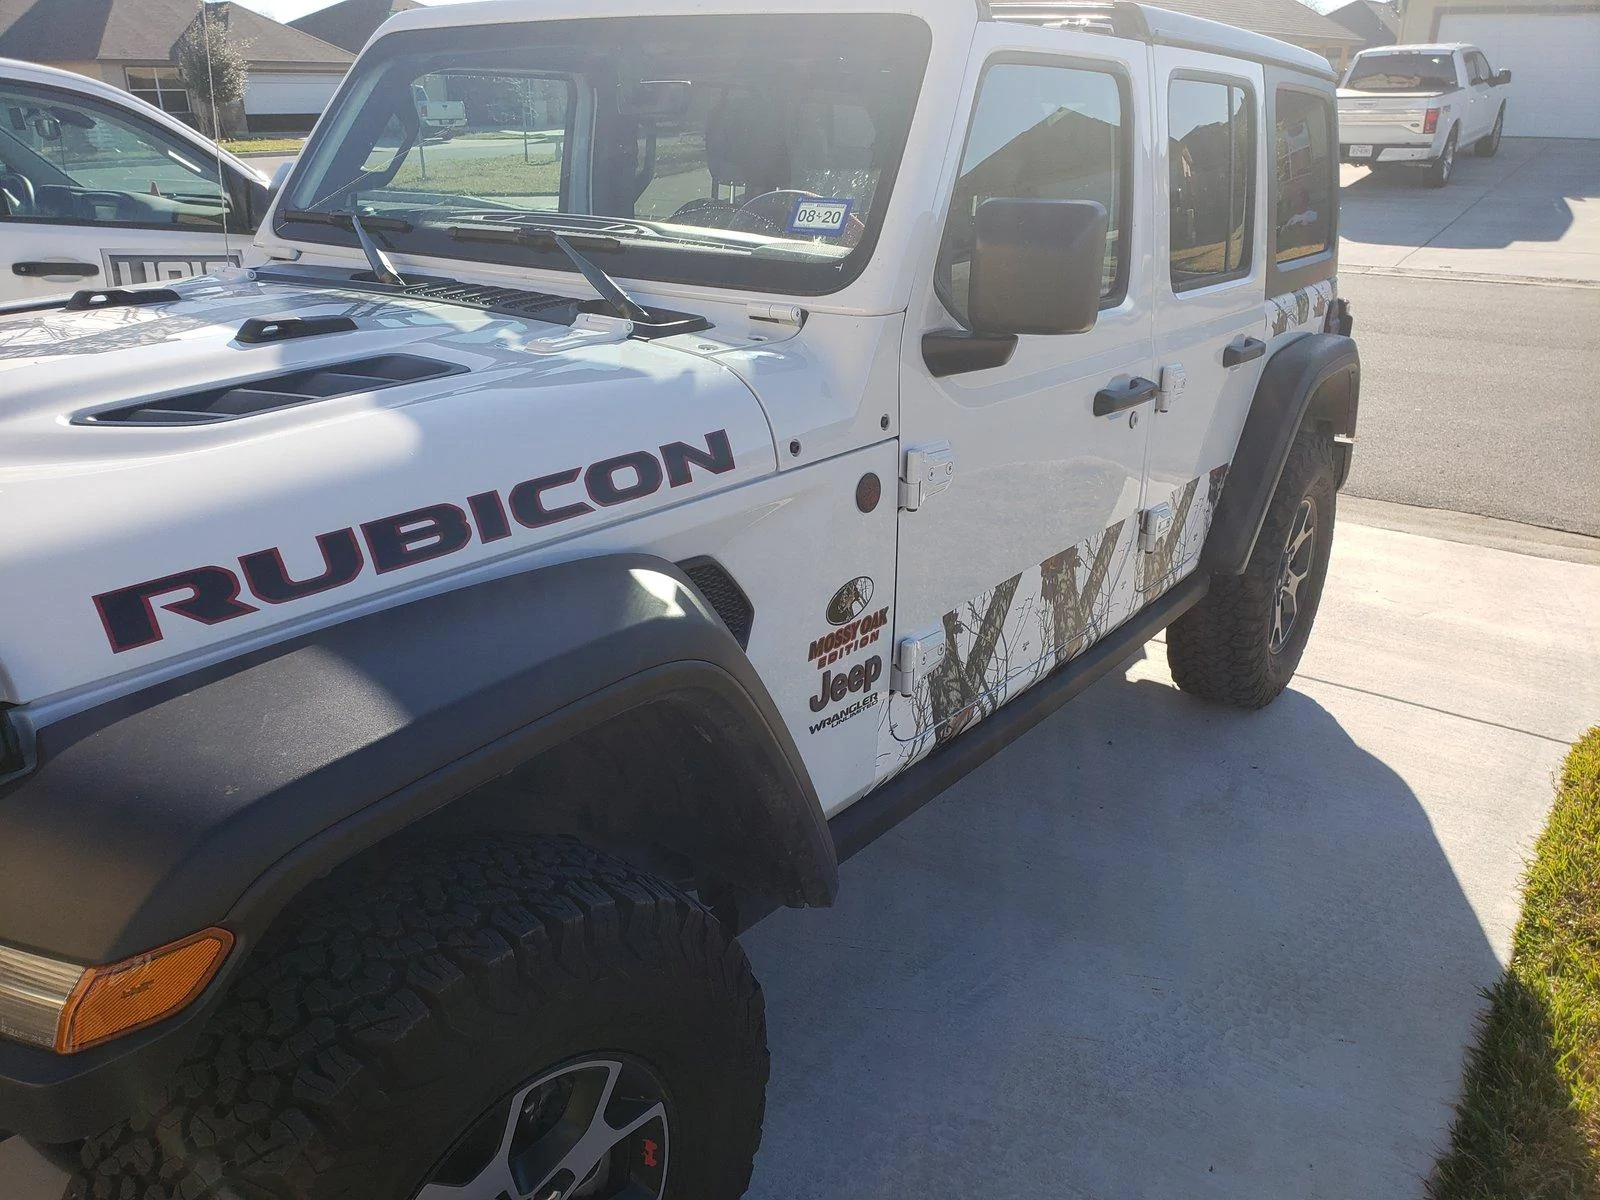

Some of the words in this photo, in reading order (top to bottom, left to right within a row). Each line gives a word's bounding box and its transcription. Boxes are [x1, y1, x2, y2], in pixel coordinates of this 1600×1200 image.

[798, 209, 817, 223] 08
[821, 210, 842, 224] 20
[91, 429, 736, 654] RUBICON
[808, 619, 862, 662] MOSSY
[860, 606, 889, 635] OAK
[817, 629, 880, 670] EDITION
[809, 655, 882, 713] Jeep
[808, 692, 879, 735] WRANGLER
[831, 699, 879, 728] UNLIMITED
